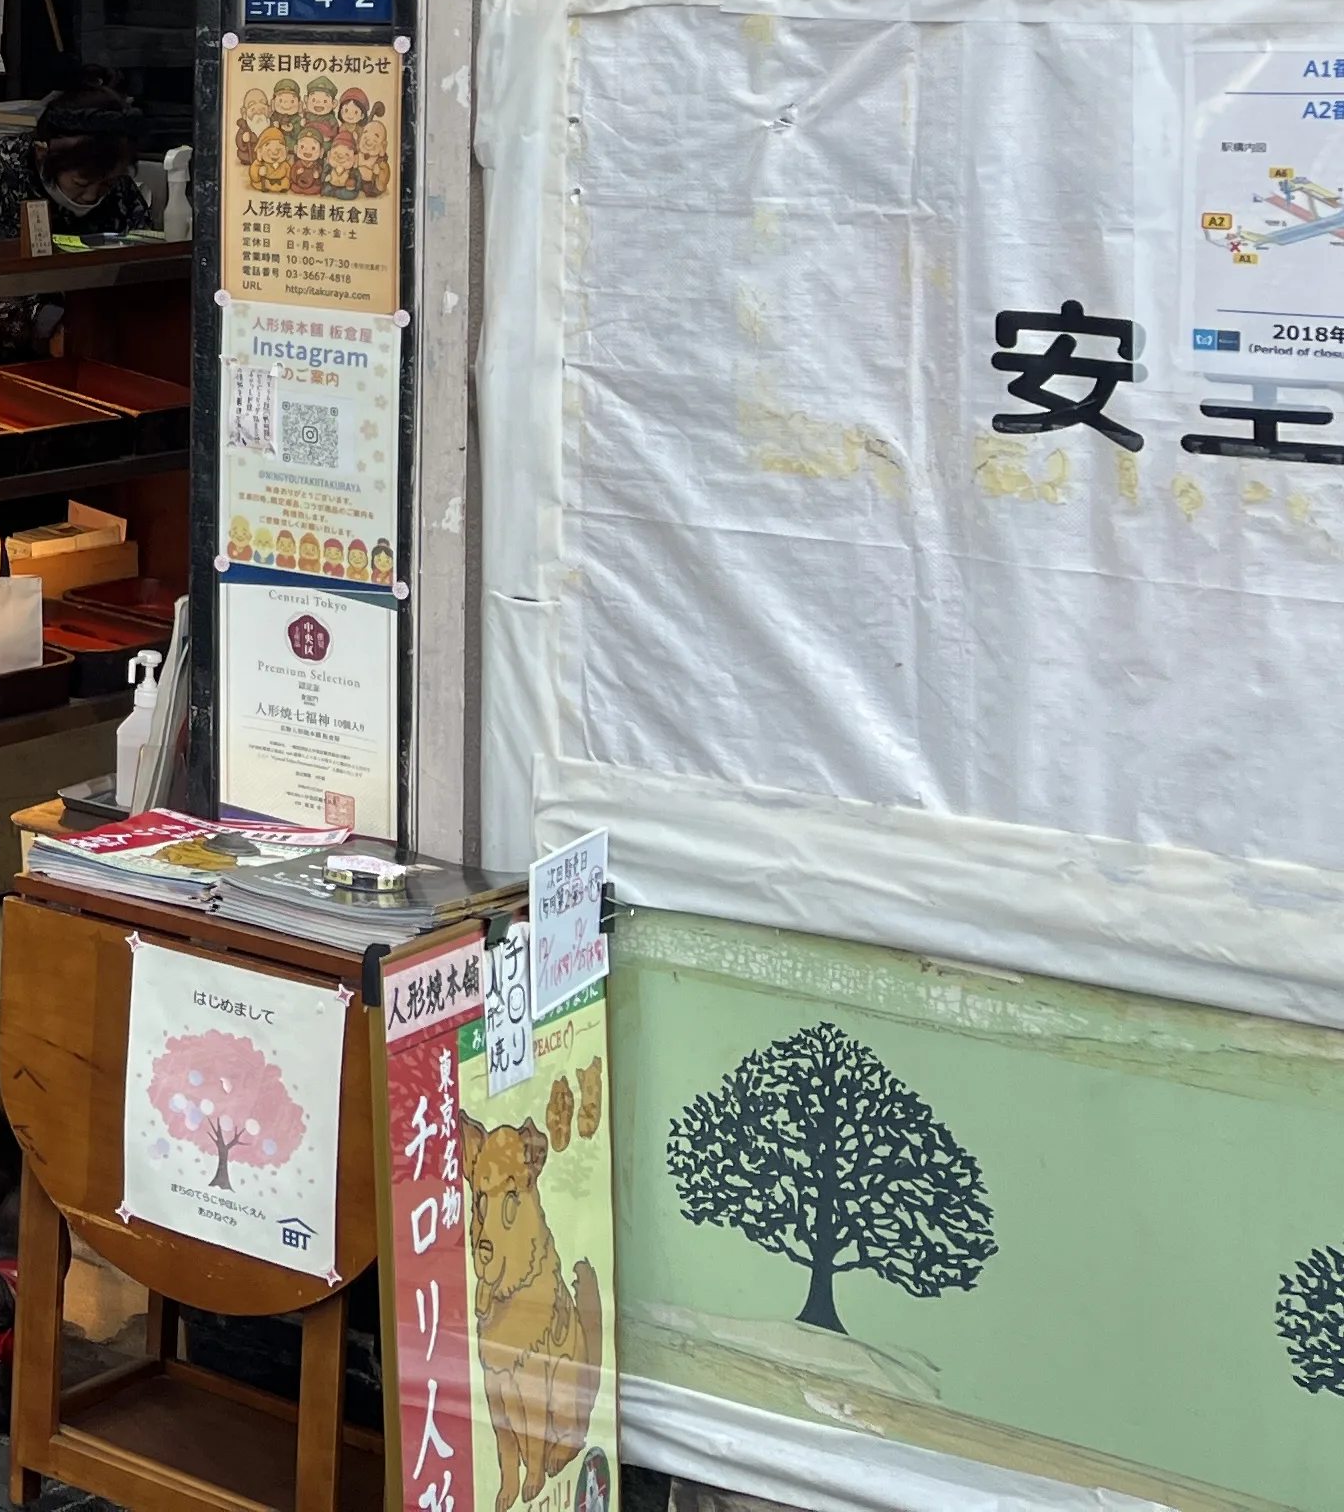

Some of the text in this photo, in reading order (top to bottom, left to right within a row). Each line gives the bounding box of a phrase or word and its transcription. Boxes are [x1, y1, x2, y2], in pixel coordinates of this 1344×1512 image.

[250, 1, 289, 16] 二丁目
[238, 52, 392, 75] 営業日時のお知らせ
[242, 200, 379, 226] 人形焼本舗 板倉屋
[1208, 216, 1226, 227] A2
[242, 222, 271, 234] 営業日
[242, 237, 271, 248] 定休日
[242, 251, 280, 264] 営業時間
[242, 265, 352, 285] 電話番号 03-3667-4818
[242, 280, 263, 292] URL
[252, 316, 374, 344] 人形焼本舗 板倉屋
[253, 336, 369, 369] Instagram
[1297, 348, 1311, 356] of
[268, 589, 348, 613] Central Tokyo
[303, 622, 314, 655] 中央区
[257, 660, 361, 689] Premium Selection
[255, 701, 330, 728] 人形焼七福神
[388, 954, 480, 1030] 人形焼本舗
[193, 990, 275, 1024] はじめまして
[438, 1048, 462, 1229] 東京名物
